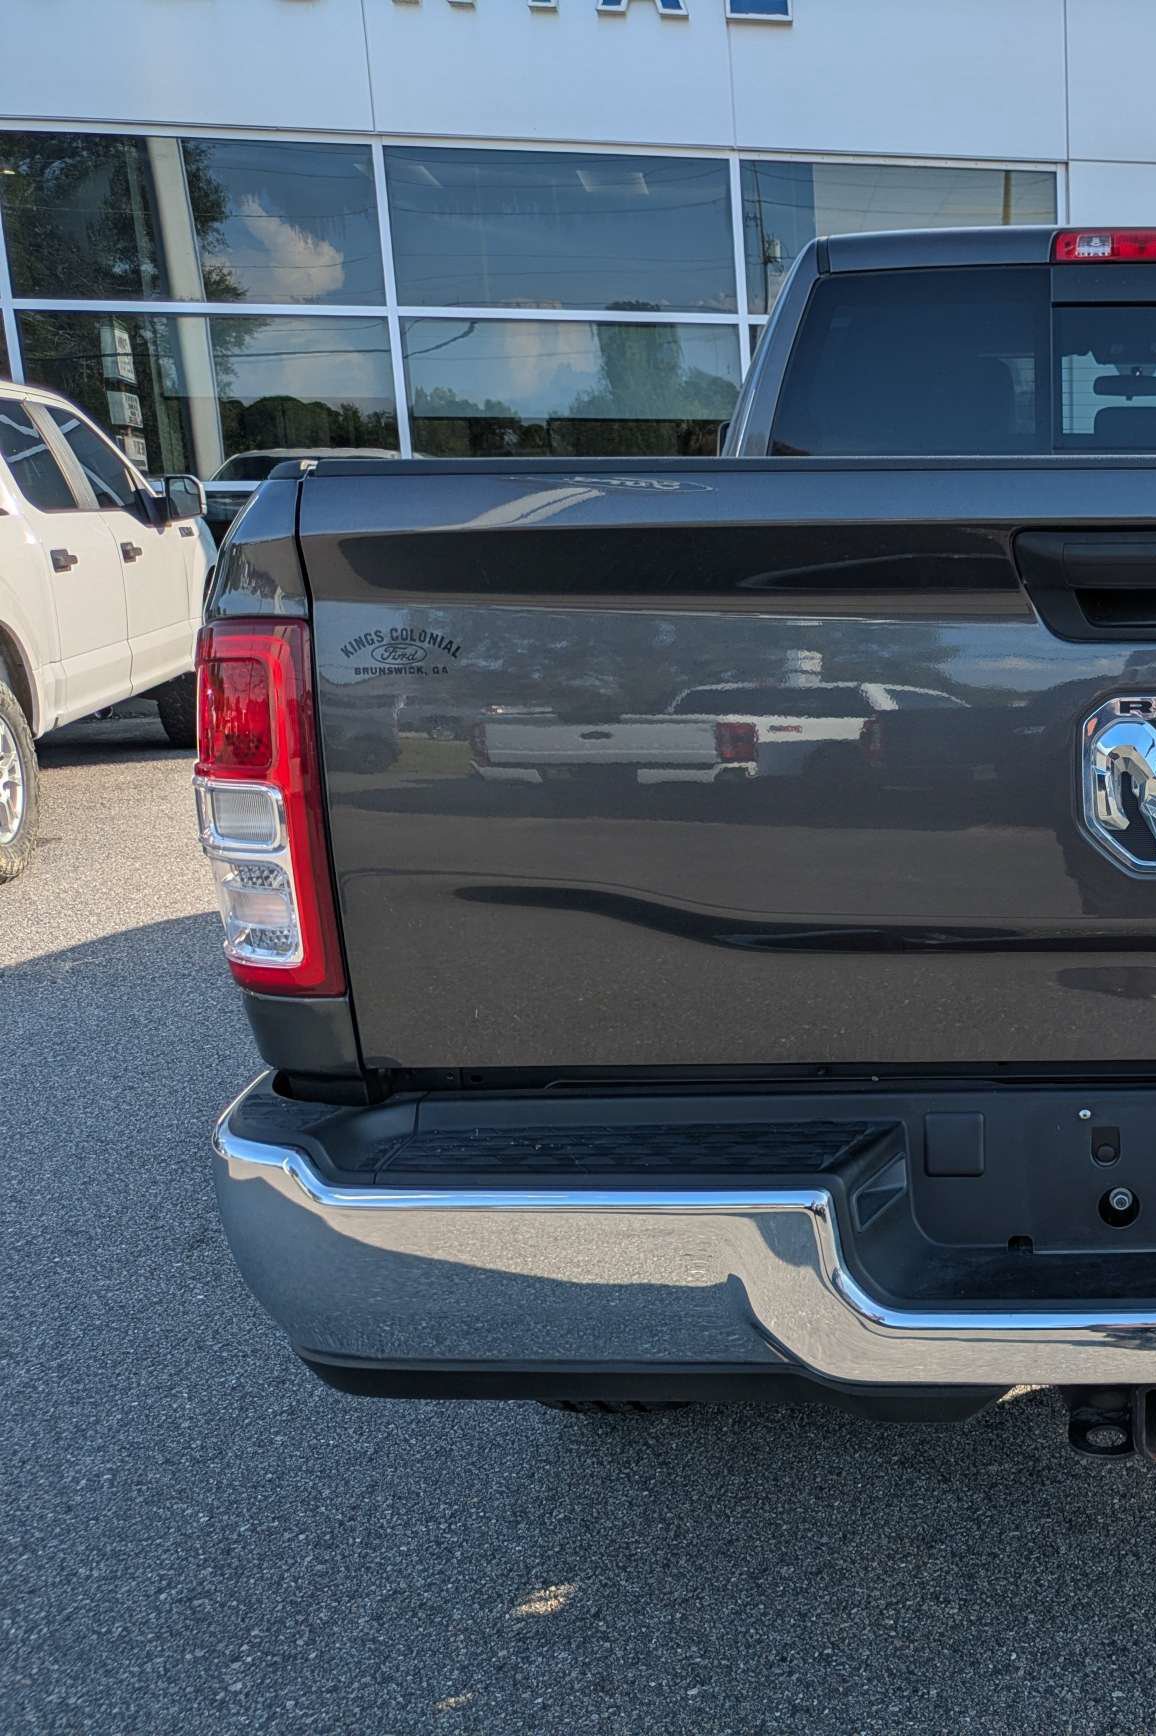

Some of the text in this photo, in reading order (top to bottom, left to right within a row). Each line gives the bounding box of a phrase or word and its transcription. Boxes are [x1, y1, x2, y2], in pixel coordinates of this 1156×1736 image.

[340, 627, 462, 659] KINGS COLONIAL
[380, 645, 418, 662] Ford
[354, 666, 448, 676] BRUNSWICK, GA
